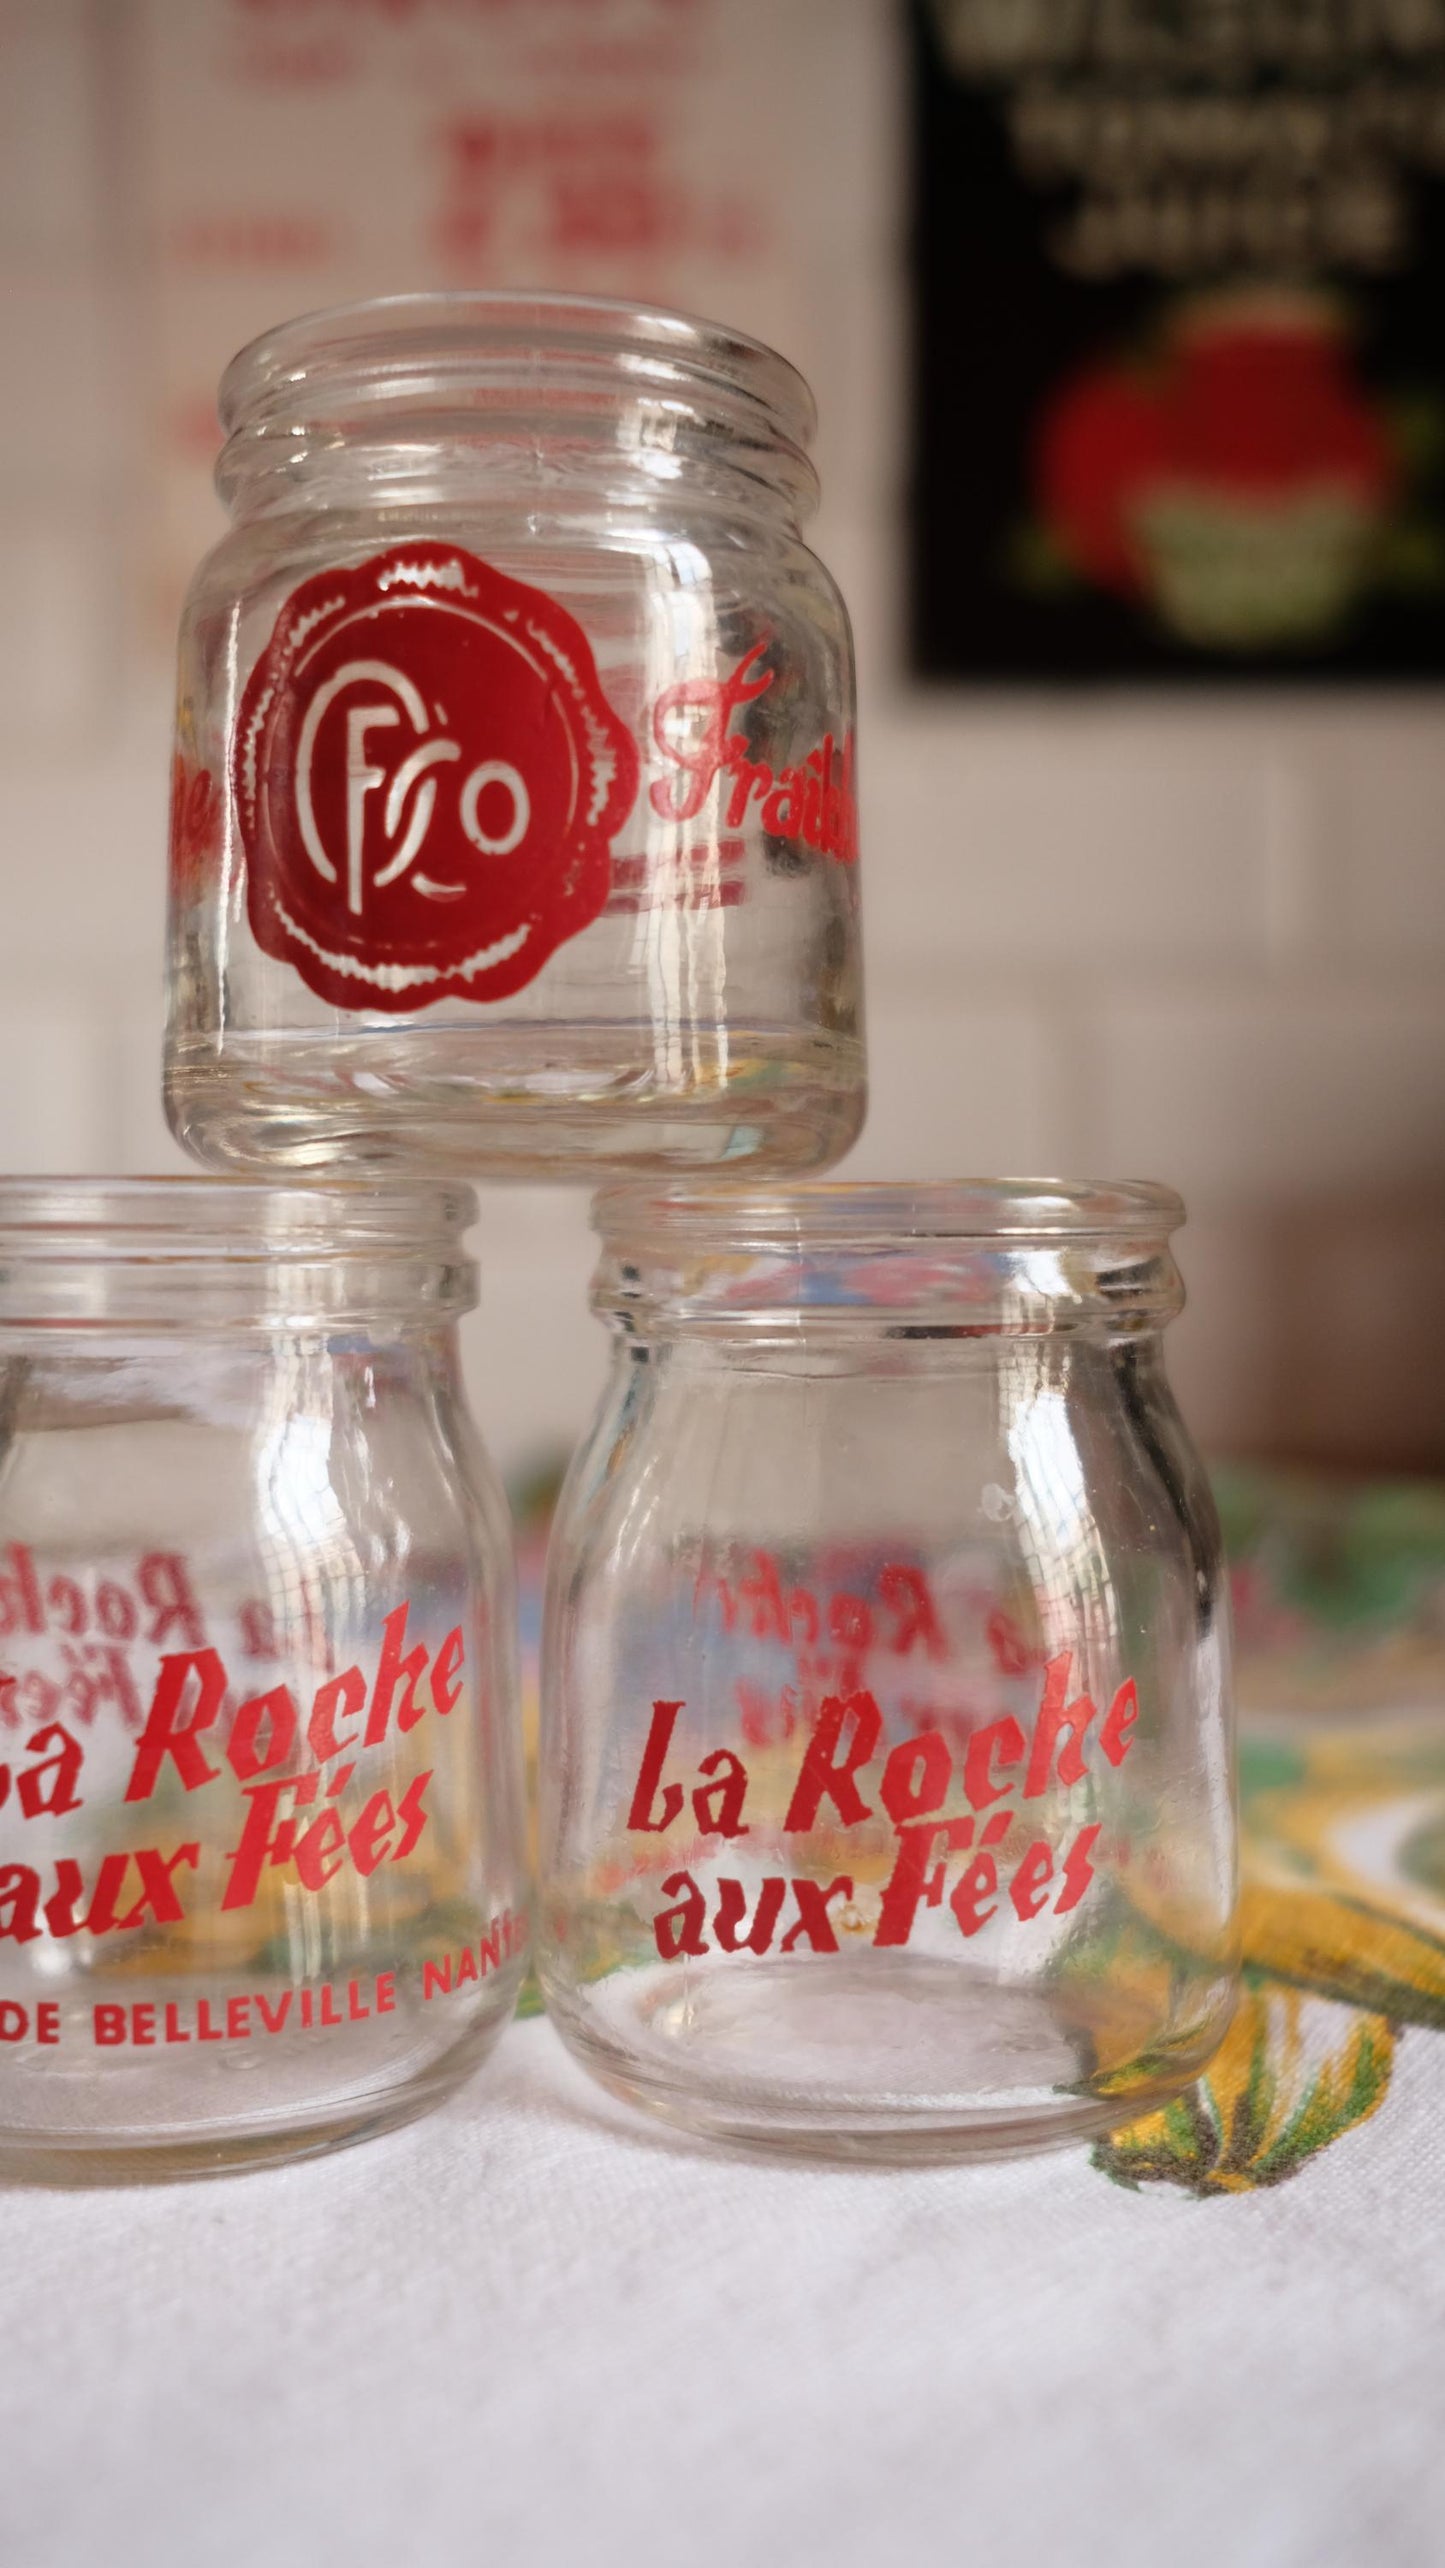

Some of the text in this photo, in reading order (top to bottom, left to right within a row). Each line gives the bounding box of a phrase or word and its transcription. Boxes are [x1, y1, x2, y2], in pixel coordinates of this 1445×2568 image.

[124, 1600, 465, 1802] Roche
[627, 1701, 749, 1836] La
[784, 1651, 1138, 1832] Roche
[0, 1764, 434, 1945] aux Fées
[653, 1811, 1102, 1959] aux Fées
[0, 2000, 60, 2044] DE
[94, 1972, 396, 2045] BELLEVILLE
